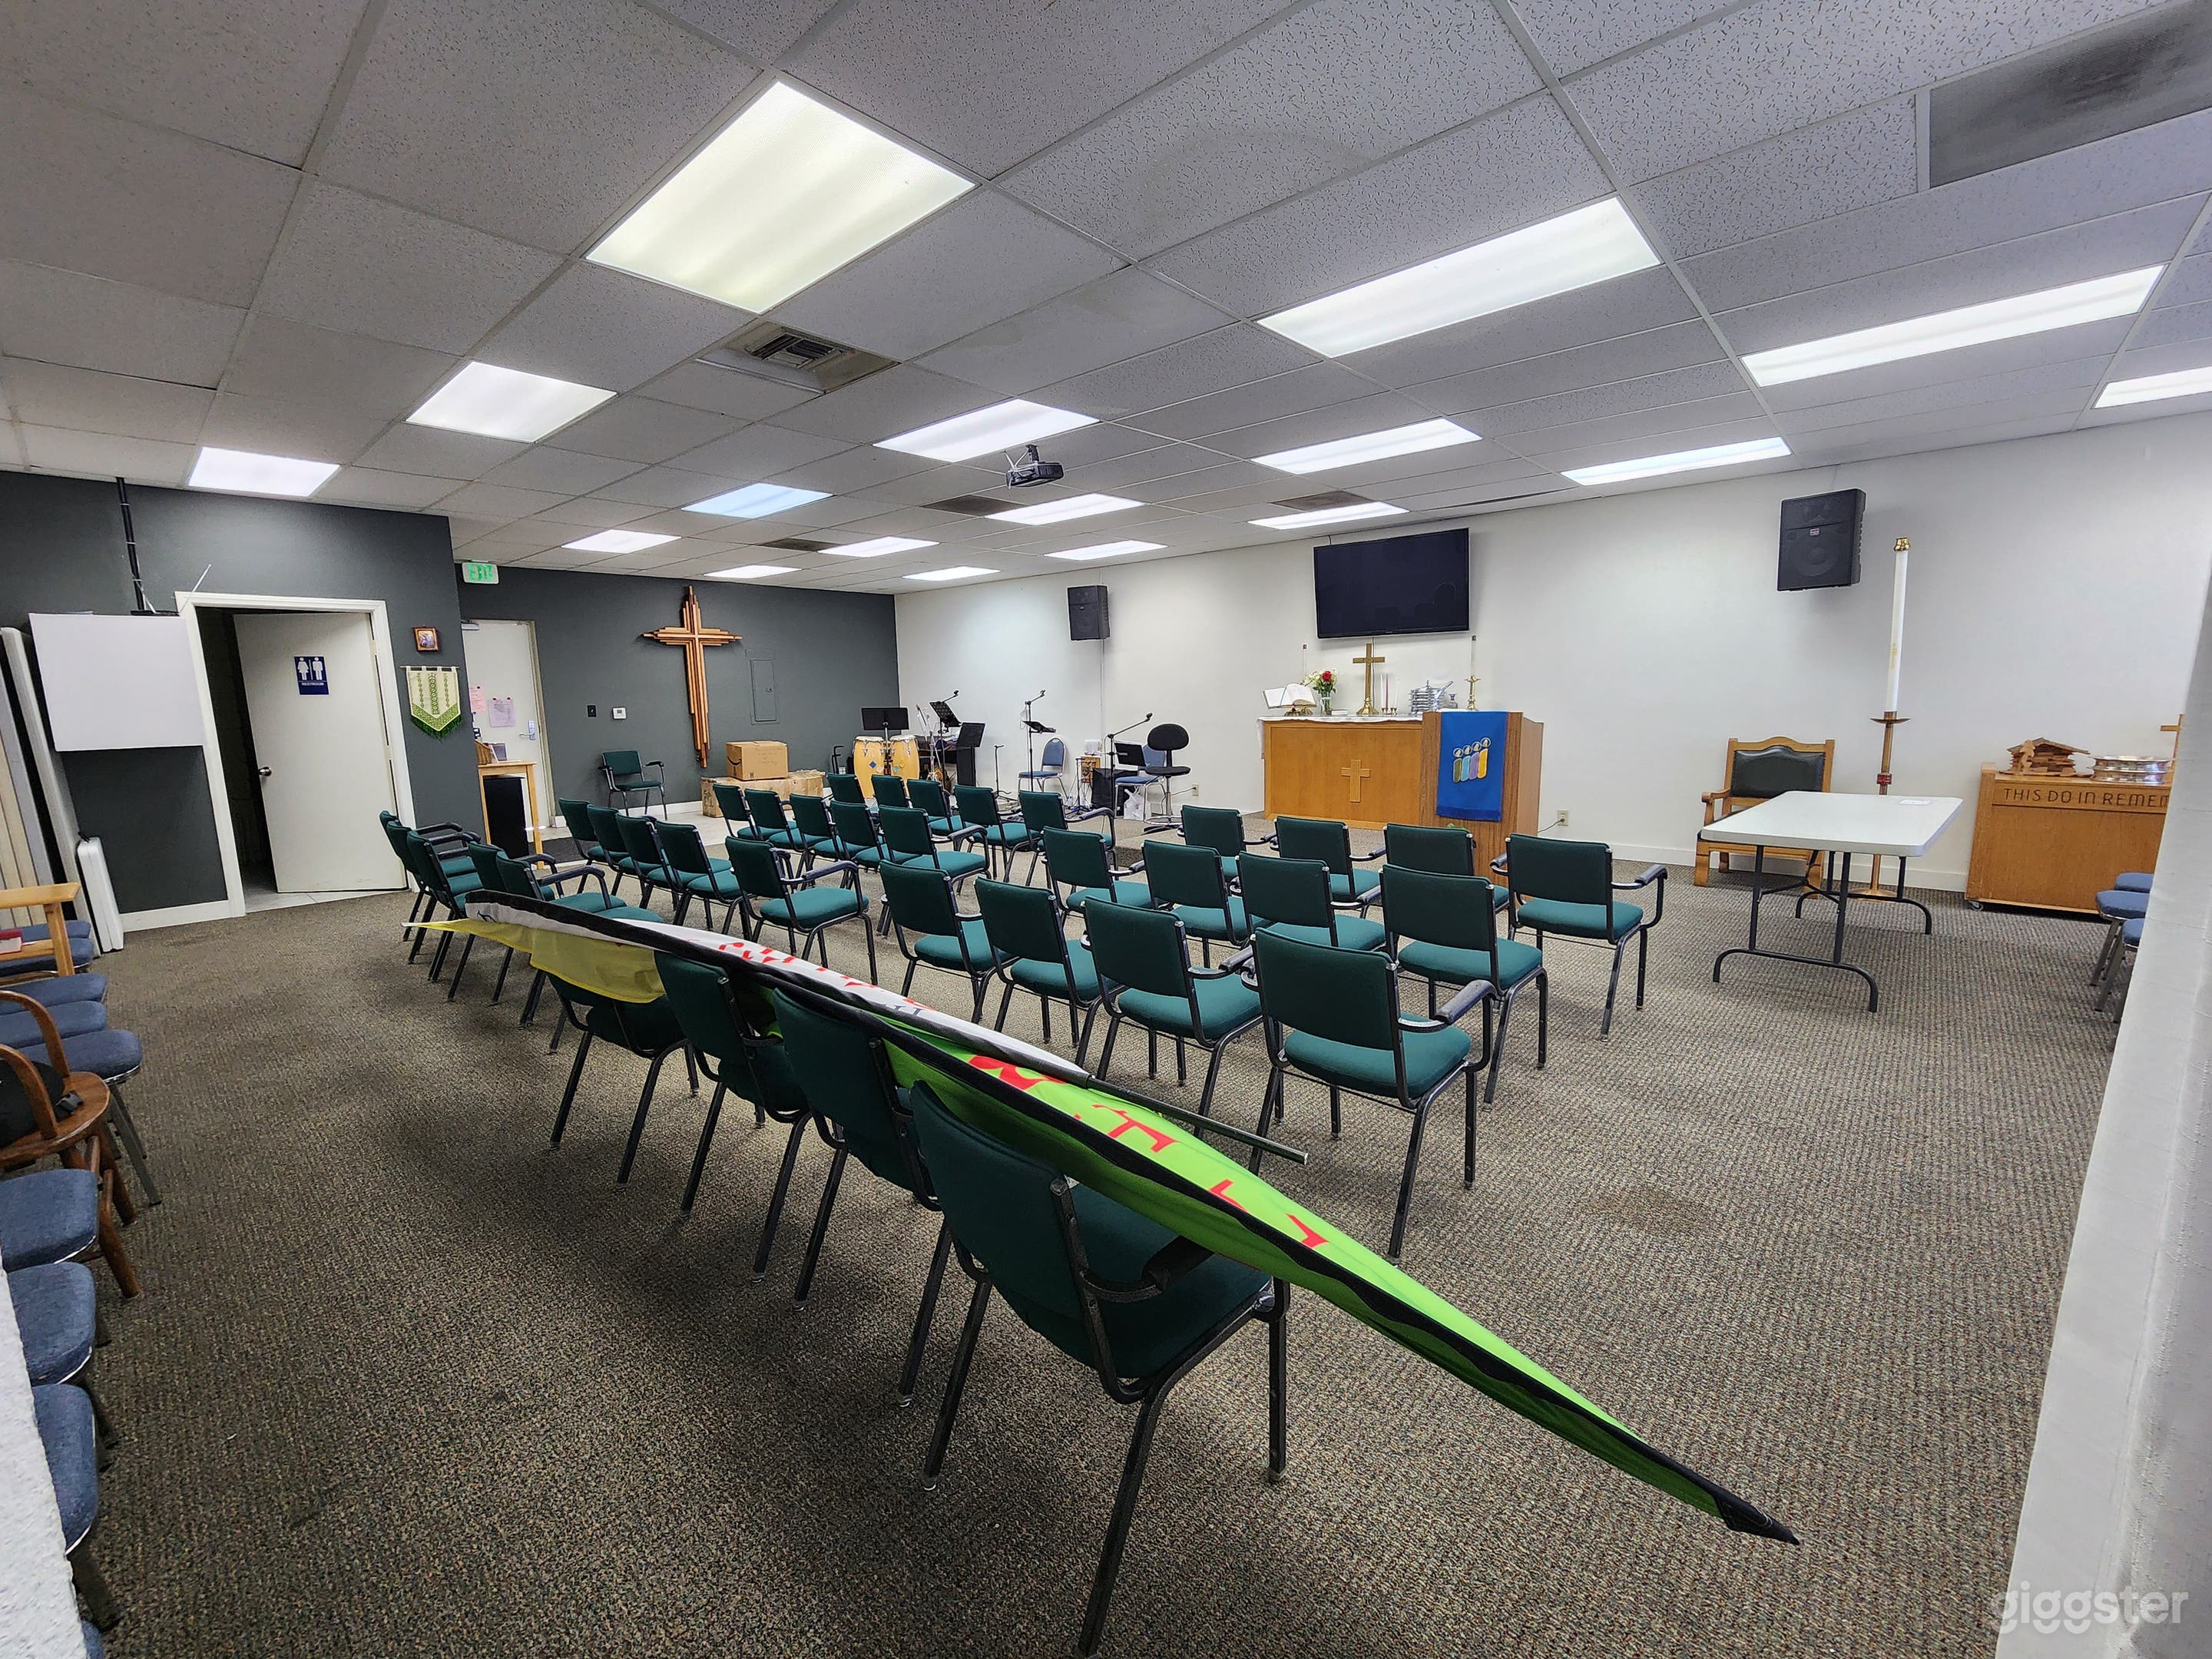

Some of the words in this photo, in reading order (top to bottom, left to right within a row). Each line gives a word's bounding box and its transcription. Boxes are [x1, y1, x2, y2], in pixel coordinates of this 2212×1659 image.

[2003, 788, 2041, 802] THIS
[2048, 790, 2072, 803] DO
[2078, 792, 2096, 804] IN
